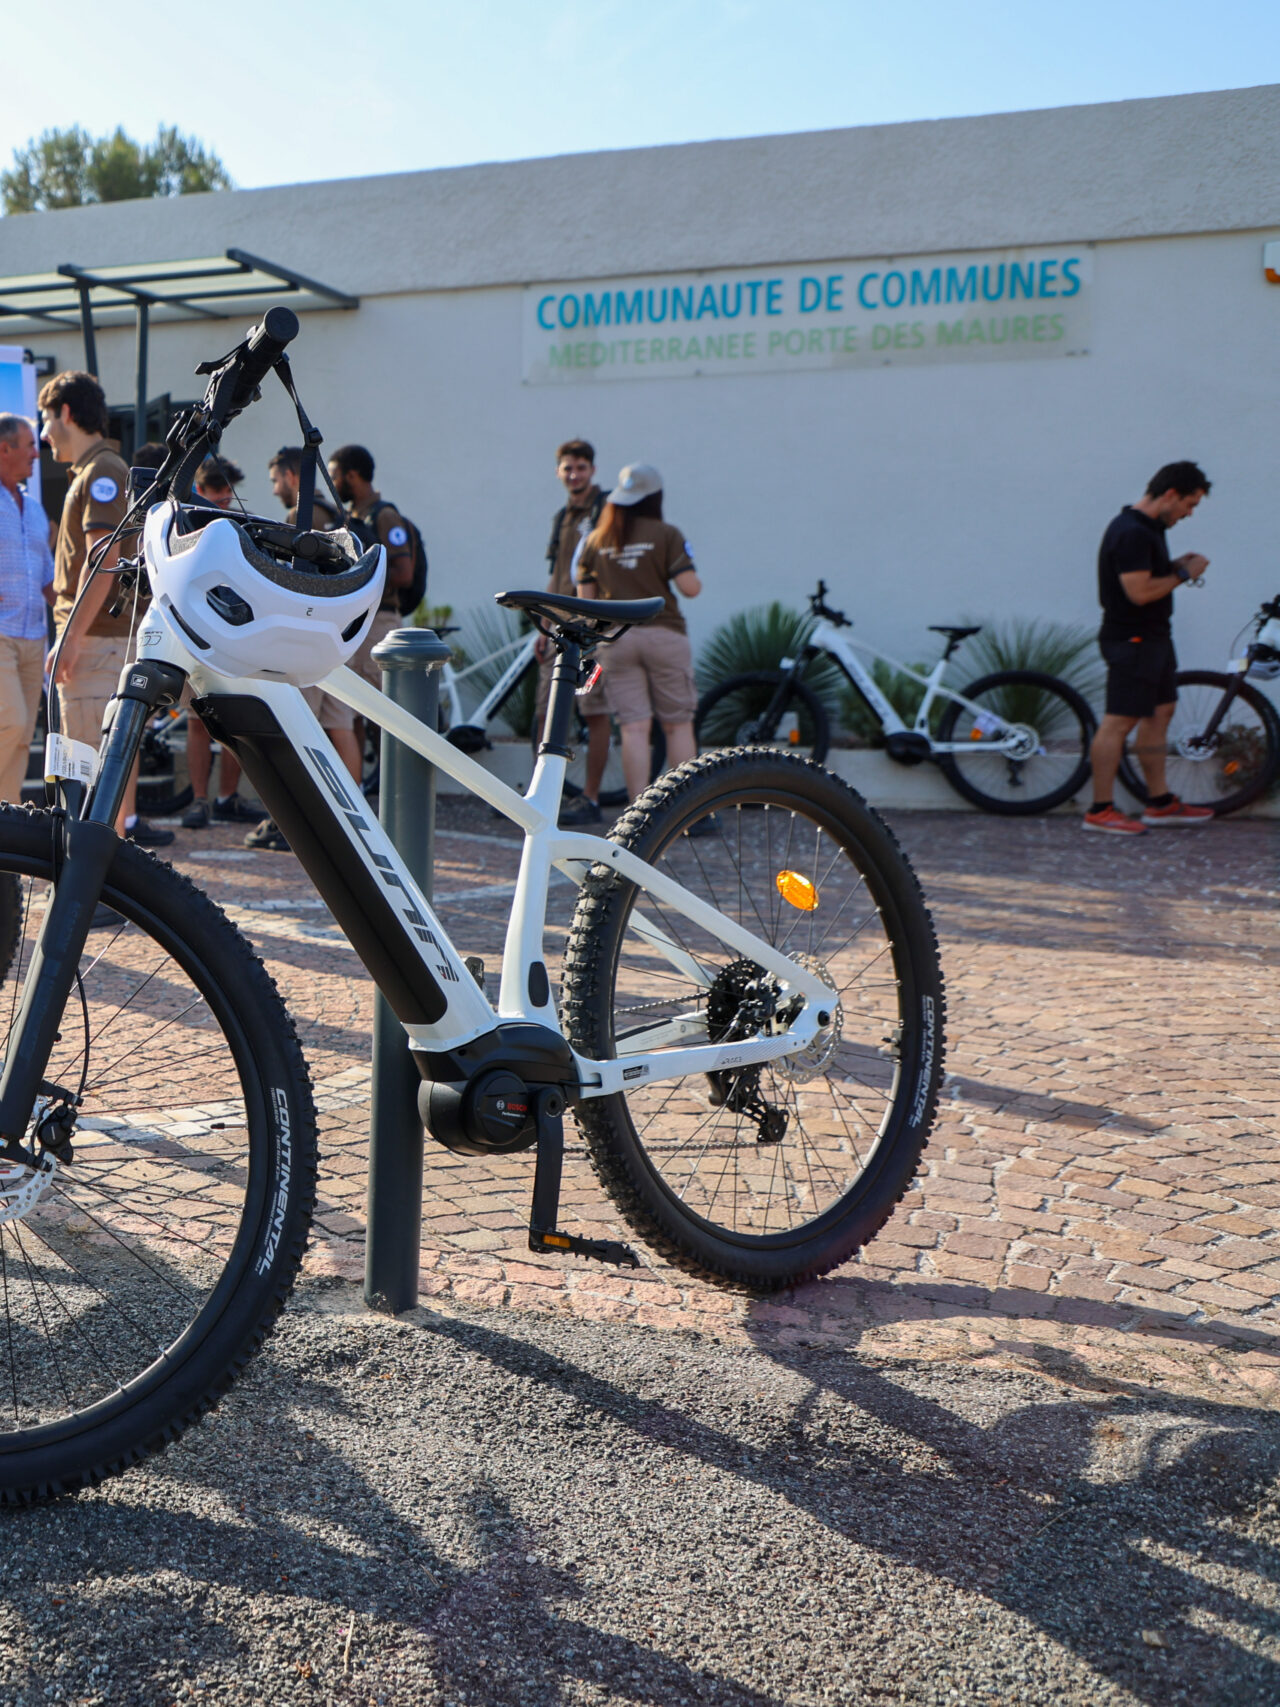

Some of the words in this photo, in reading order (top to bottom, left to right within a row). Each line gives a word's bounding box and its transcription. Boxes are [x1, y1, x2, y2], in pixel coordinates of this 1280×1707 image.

[536, 279, 784, 331] COMMUNAUTE
[798, 274, 844, 314] DE
[857, 258, 1081, 310] COMMUNES
[548, 331, 758, 371] MEDITERRANEE
[768, 325, 859, 357] PORTE
[871, 321, 925, 351] DES
[934, 313, 1065, 346] MAURES
[303, 745, 460, 983] SUNN
[911, 994, 935, 1129] CONTINENTAL
[258, 1087, 292, 1276] CONTINENTAL
